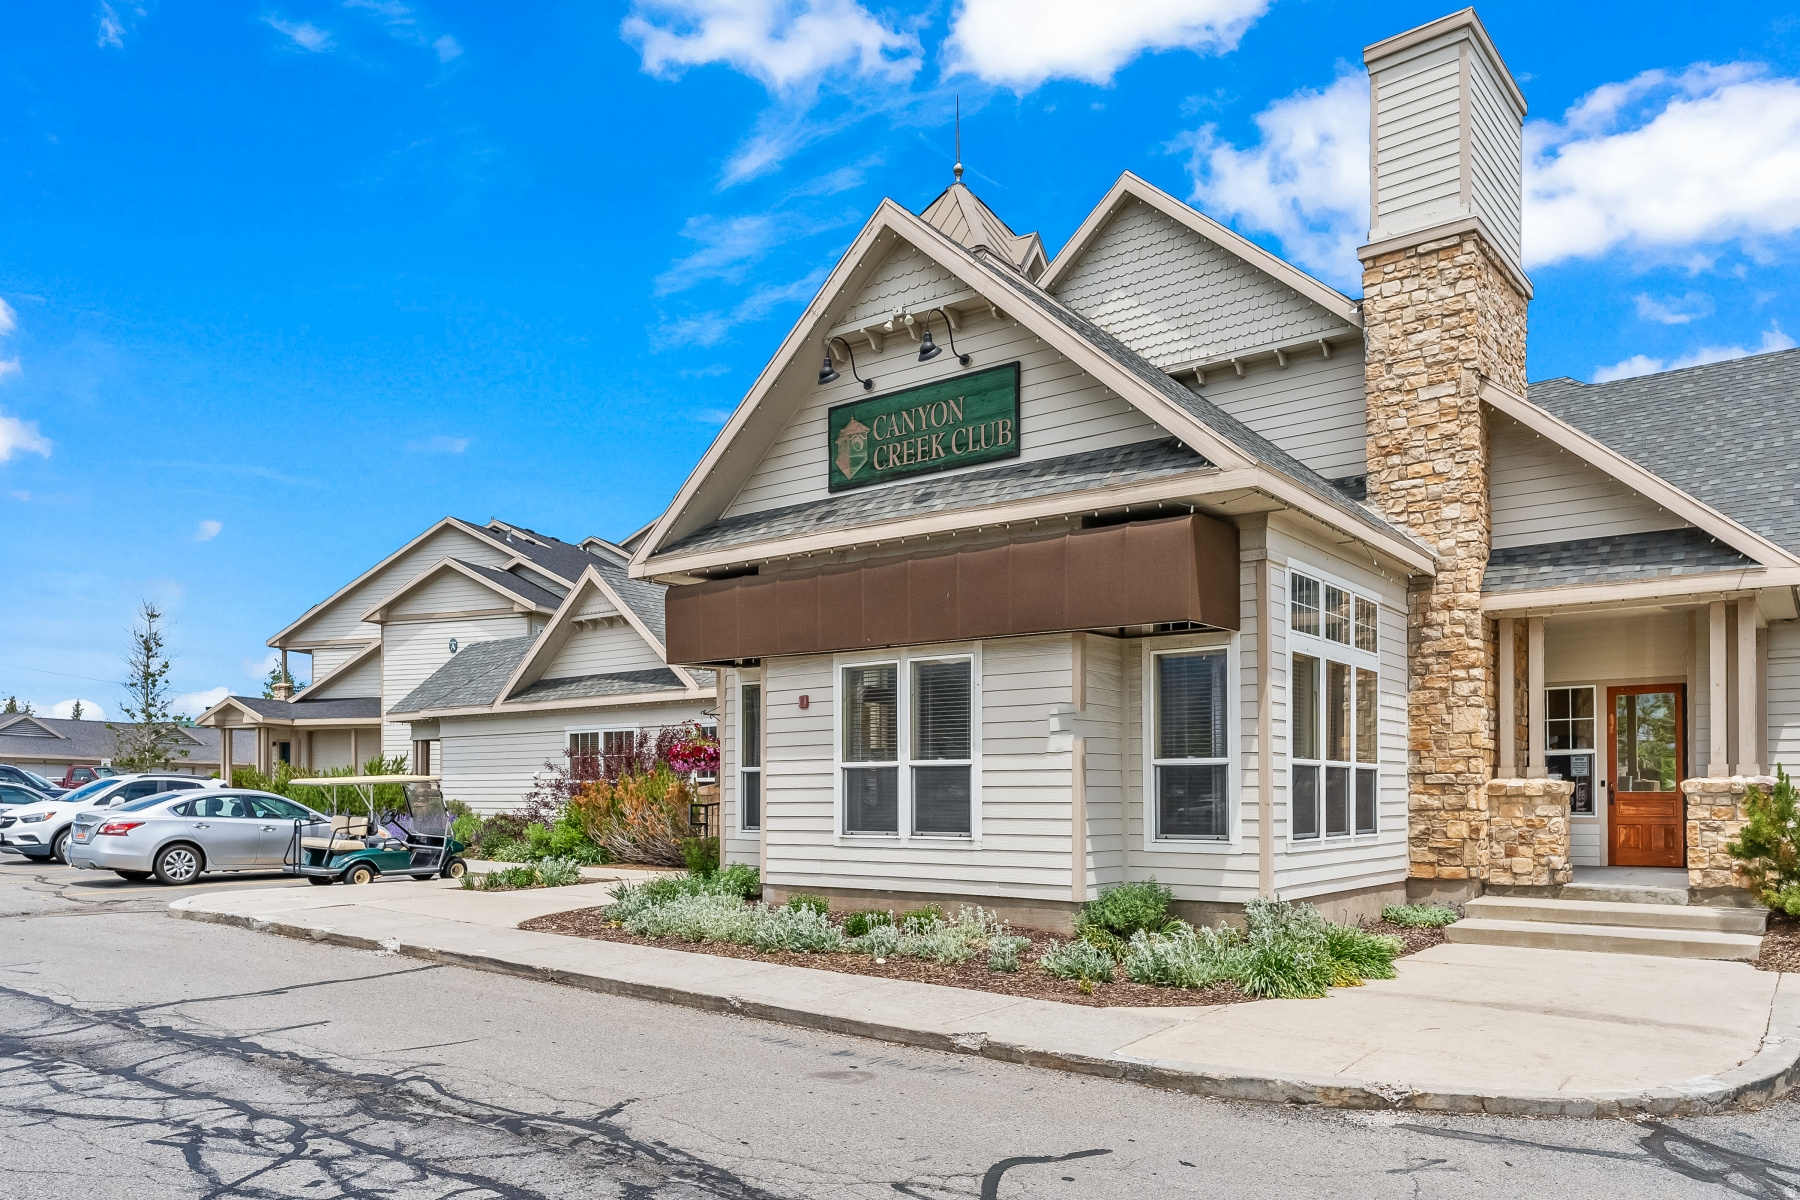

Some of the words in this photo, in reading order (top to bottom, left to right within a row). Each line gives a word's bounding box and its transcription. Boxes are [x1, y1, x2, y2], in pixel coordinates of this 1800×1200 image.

[873, 396, 965, 441] CANYON
[873, 432, 946, 471] CREEK
[951, 418, 1013, 455] CLUB
